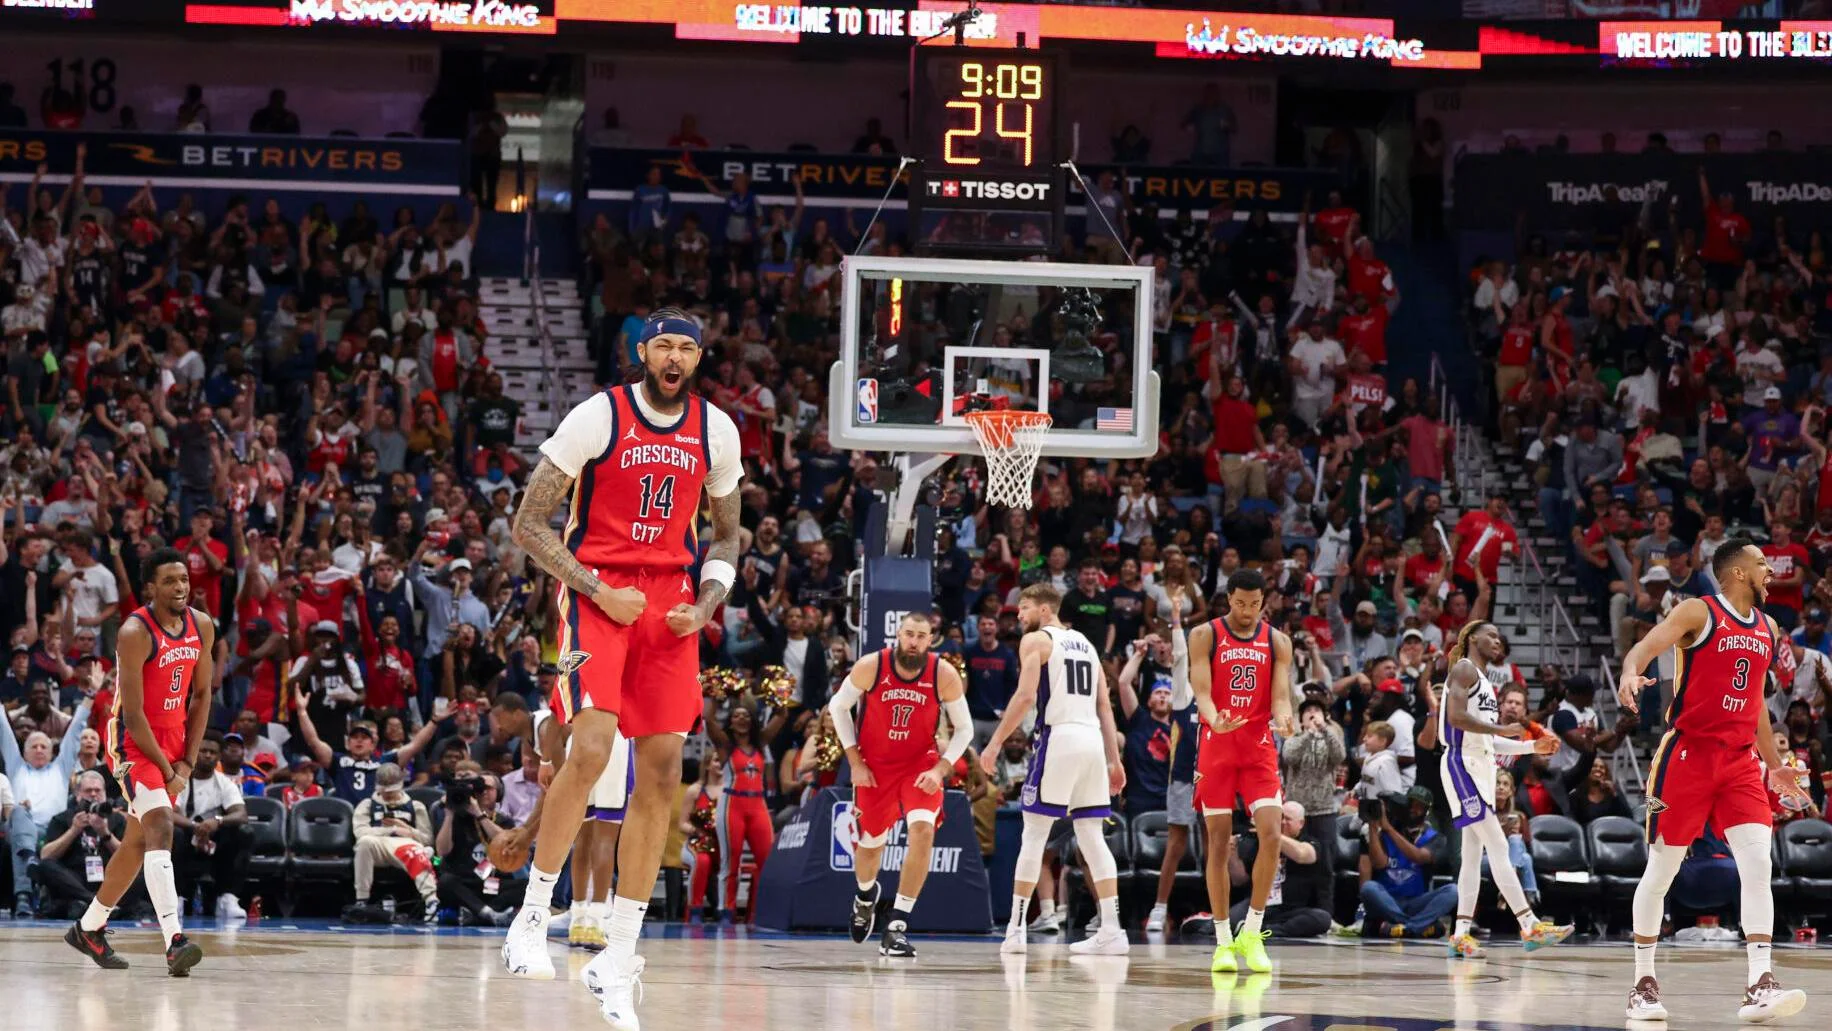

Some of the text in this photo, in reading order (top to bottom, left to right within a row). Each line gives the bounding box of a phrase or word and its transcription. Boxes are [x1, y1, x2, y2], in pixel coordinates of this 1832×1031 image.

[832, 7, 862, 35] TO
[866, 8, 905, 36] THE
[1616, 31, 1712, 58] WELCOME
[1716, 31, 1743, 58] TO
[1746, 31, 1787, 58] THE
[961, 62, 1043, 100] 9:09
[944, 101, 1034, 167] 24
[182, 145, 404, 171] BETRIVERS
[722, 161, 912, 187] BETRIVER
[961, 181, 1051, 201] TISSOT
[620, 444, 699, 476] CRESCENT
[638, 473, 676, 520] 14
[158, 646, 201, 669] CRESCENT
[1219, 647, 1268, 666] CRESCENT
[1716, 634, 1771, 661] CRESCENT
[169, 665, 185, 694] 5
[1063, 657, 1092, 698] 10
[1229, 664, 1257, 692] 25
[1731, 657, 1752, 692] 3
[163, 694, 183, 712] CITY
[881, 688, 928, 706] CRESCENT
[1230, 694, 1253, 709] CITY
[1721, 694, 1748, 713] CITY
[891, 703, 916, 729] 17
[888, 728, 911, 742] CITY
[353, 770, 366, 791] 3
